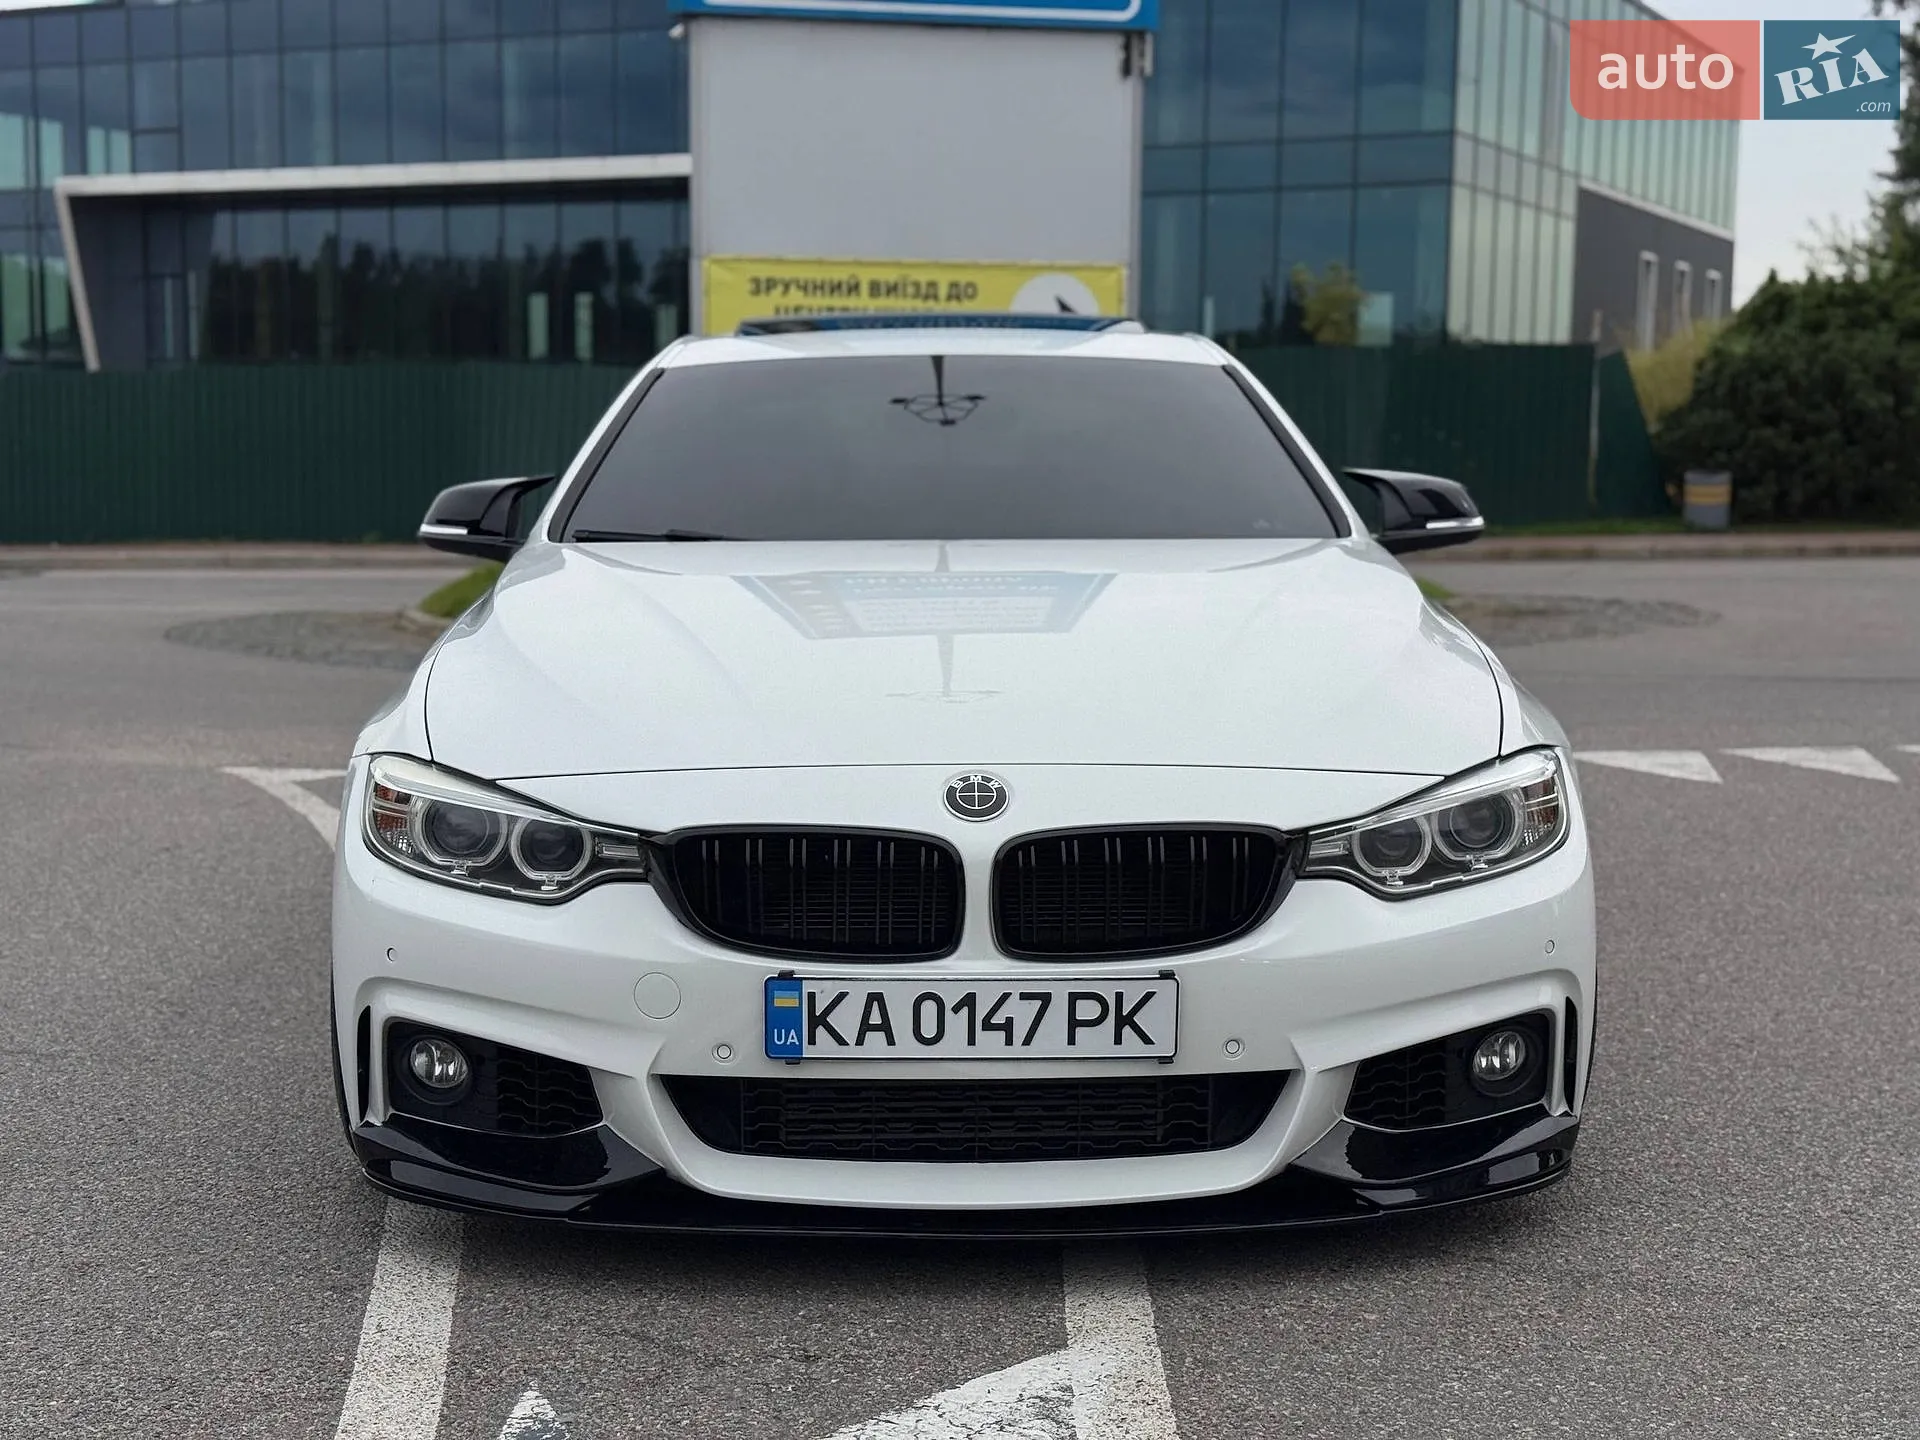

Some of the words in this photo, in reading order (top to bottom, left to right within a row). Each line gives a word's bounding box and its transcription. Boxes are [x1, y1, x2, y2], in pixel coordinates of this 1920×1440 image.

[749, 273, 860, 297] ЗРУЧНИЙ
[868, 274, 939, 303] ВИЇЗД
[946, 280, 978, 303] ДО
[950, 775, 1002, 788] BMW
[807, 991, 896, 1046] KA
[912, 991, 1053, 1046] 0147
[1067, 991, 1157, 1046] PK
[774, 1029, 799, 1045] UA
